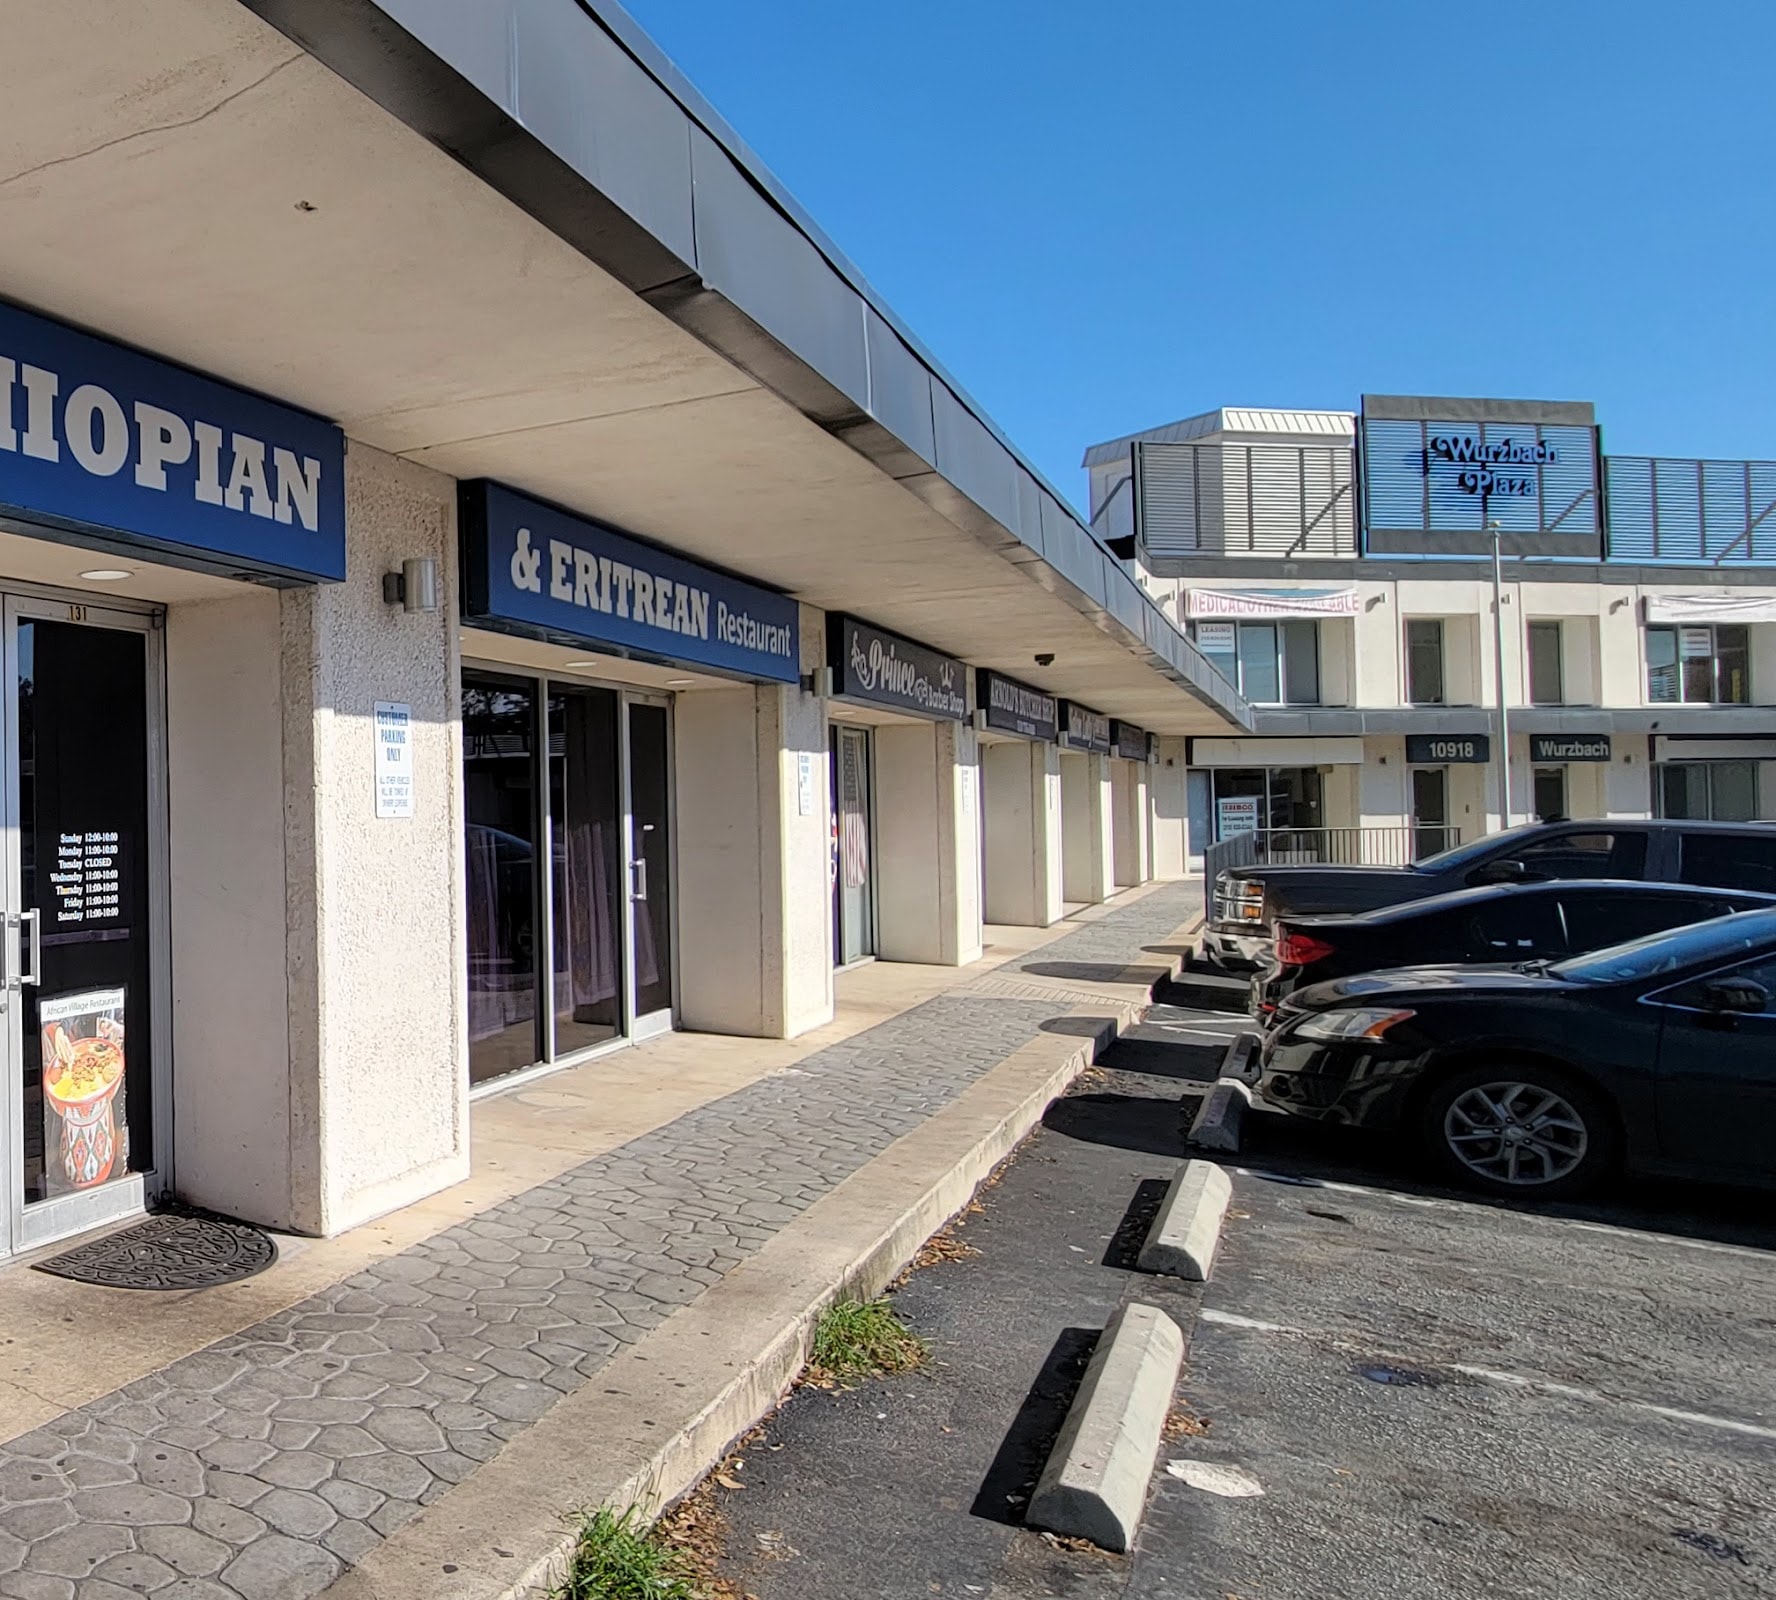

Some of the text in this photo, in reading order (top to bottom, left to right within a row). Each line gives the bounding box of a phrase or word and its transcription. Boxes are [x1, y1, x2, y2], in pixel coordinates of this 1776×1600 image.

[1434, 436, 1559, 464] Wurzbach
[1463, 471, 1536, 496] Plaza
[511, 528, 791, 658] & ERITREAN Restaurant
[70, 605, 87, 622] 131
[864, 639, 915, 697] Prince
[949, 691, 964, 719] Shop
[381, 729, 406, 744] PARKING
[1430, 741, 1474, 758] 10918
[1539, 740, 1609, 757] Wurzbach
[85, 832, 118, 842] 12:00-10:00
[58, 845, 118, 857] Monday 11:00-10:00
[84, 857, 112, 867] CLOSED
[85, 870, 118, 880] 11:00-10:00
[86, 882, 118, 893] 11:00-10:00
[64, 895, 118, 909] Friday 11:00-10:00
[86, 907, 119, 919] 11:00-10:00
[46, 996, 121, 1016] African Village Restaurant
